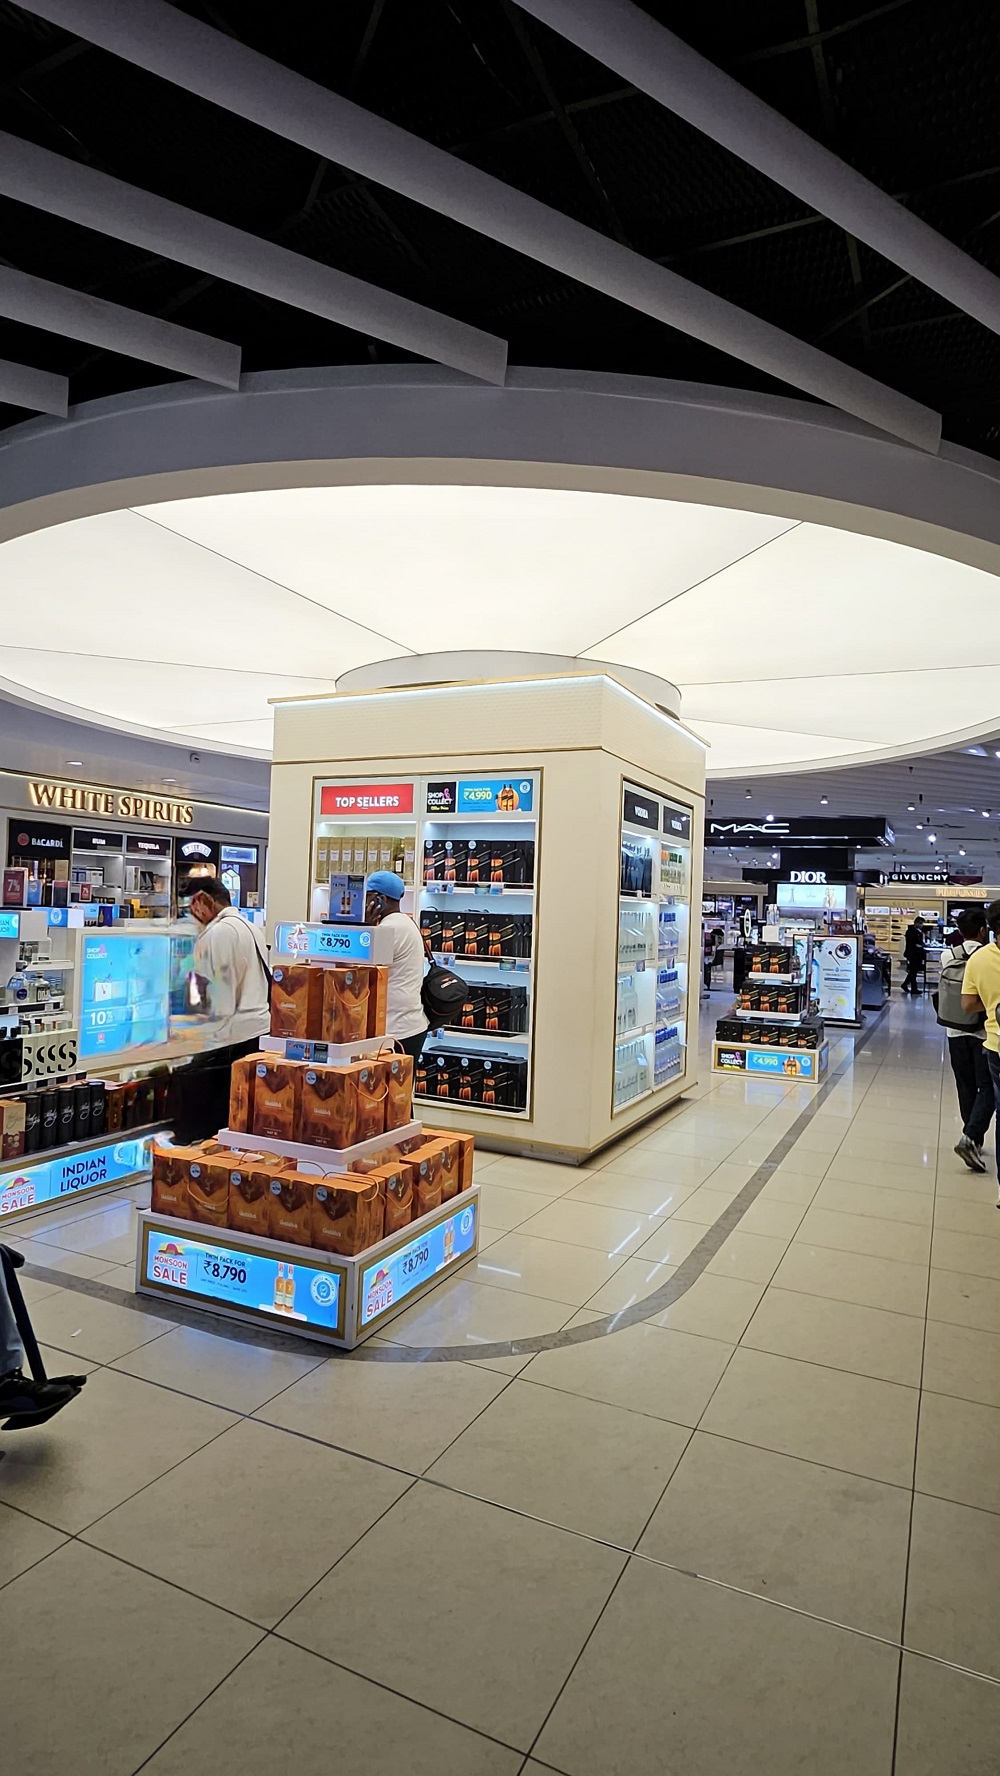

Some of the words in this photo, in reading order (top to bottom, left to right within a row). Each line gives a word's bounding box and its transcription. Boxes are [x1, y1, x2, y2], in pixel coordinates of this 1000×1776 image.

[30, 783, 114, 814] WHITE
[119, 796, 193, 824] SPIRITS
[335, 797, 355, 808] TOP
[357, 796, 399, 807] SELLERS
[31, 837, 64, 848] BACARDÍ
[789, 870, 828, 884] DIOR
[891, 873, 949, 882] GIVENCHY
[7, 879, 21, 892] 7%
[287, 941, 309, 950] SALE
[320, 936, 350, 949] ₹8,790
[90, 1010, 113, 1026] 10%
[62, 1155, 106, 1178] INDIAN
[60, 1169, 107, 1193] LIQUOR
[2, 1186, 35, 1199] MONSOON
[1, 1194, 35, 1213] SALE
[154, 1254, 188, 1270] MONSOON
[219, 1256, 233, 1265] PACK
[234, 1259, 246, 1267] FOR
[402, 1247, 429, 1275] ₹8,790
[153, 1265, 188, 1286] SALE
[203, 1259, 247, 1284] ₹8,790
[367, 1279, 393, 1301] MONSOON
[367, 1290, 393, 1318] SALE
